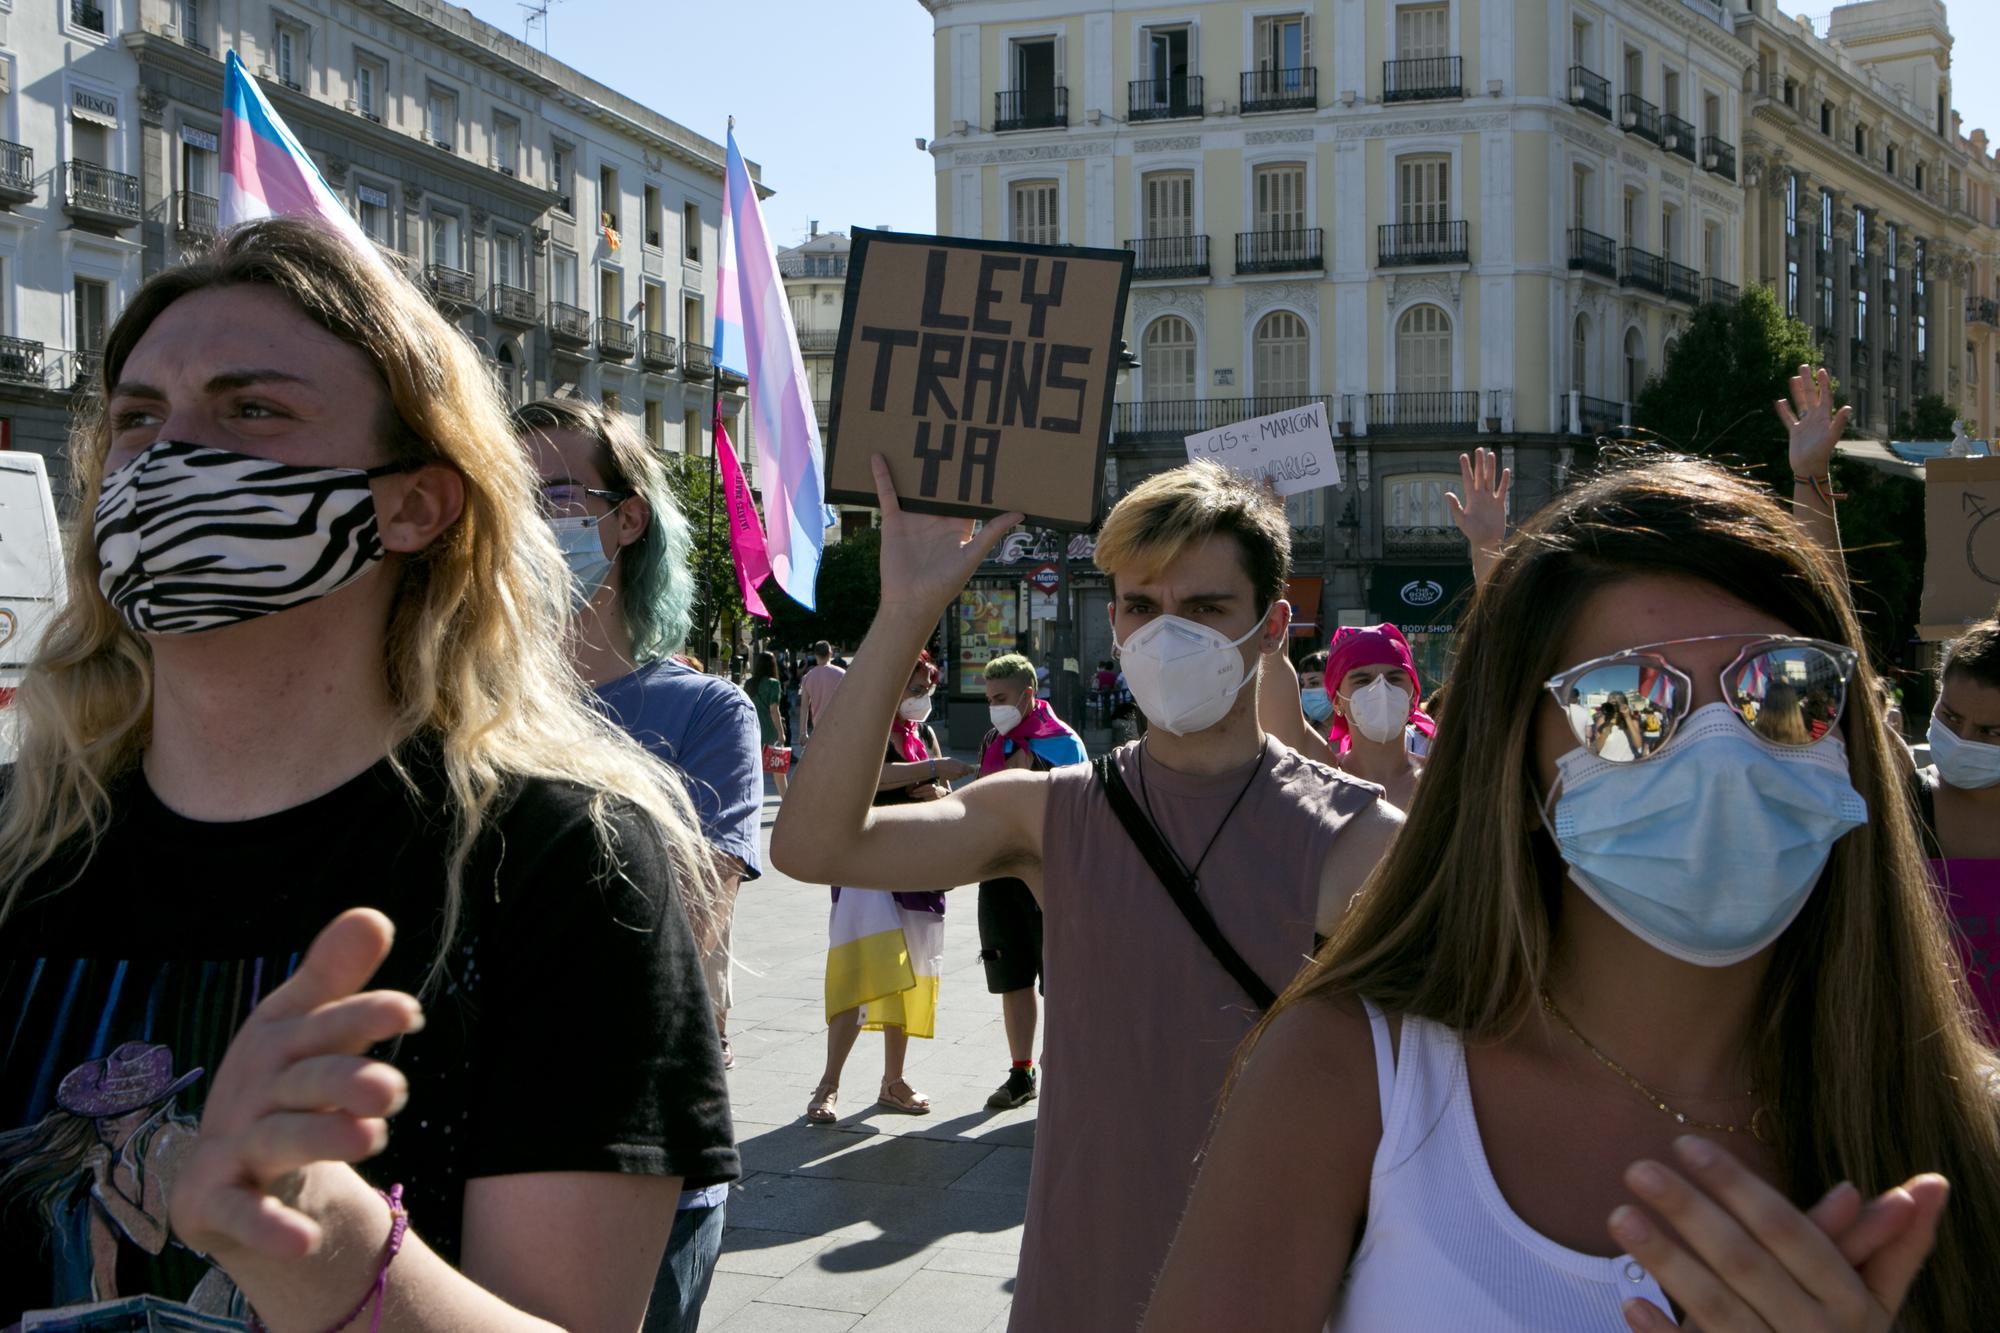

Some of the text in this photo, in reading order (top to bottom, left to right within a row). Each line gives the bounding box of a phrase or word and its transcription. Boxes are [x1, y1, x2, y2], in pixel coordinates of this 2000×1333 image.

[76, 92, 114, 116] RIESCO
[920, 249, 1068, 338] LEY
[861, 326, 1093, 434] TRANS
[1260, 410, 1319, 440] MARICÓN
[913, 421, 1001, 504] YA
[1037, 574, 1059, 582] Metro
[1402, 624, 1425, 633] BODY
